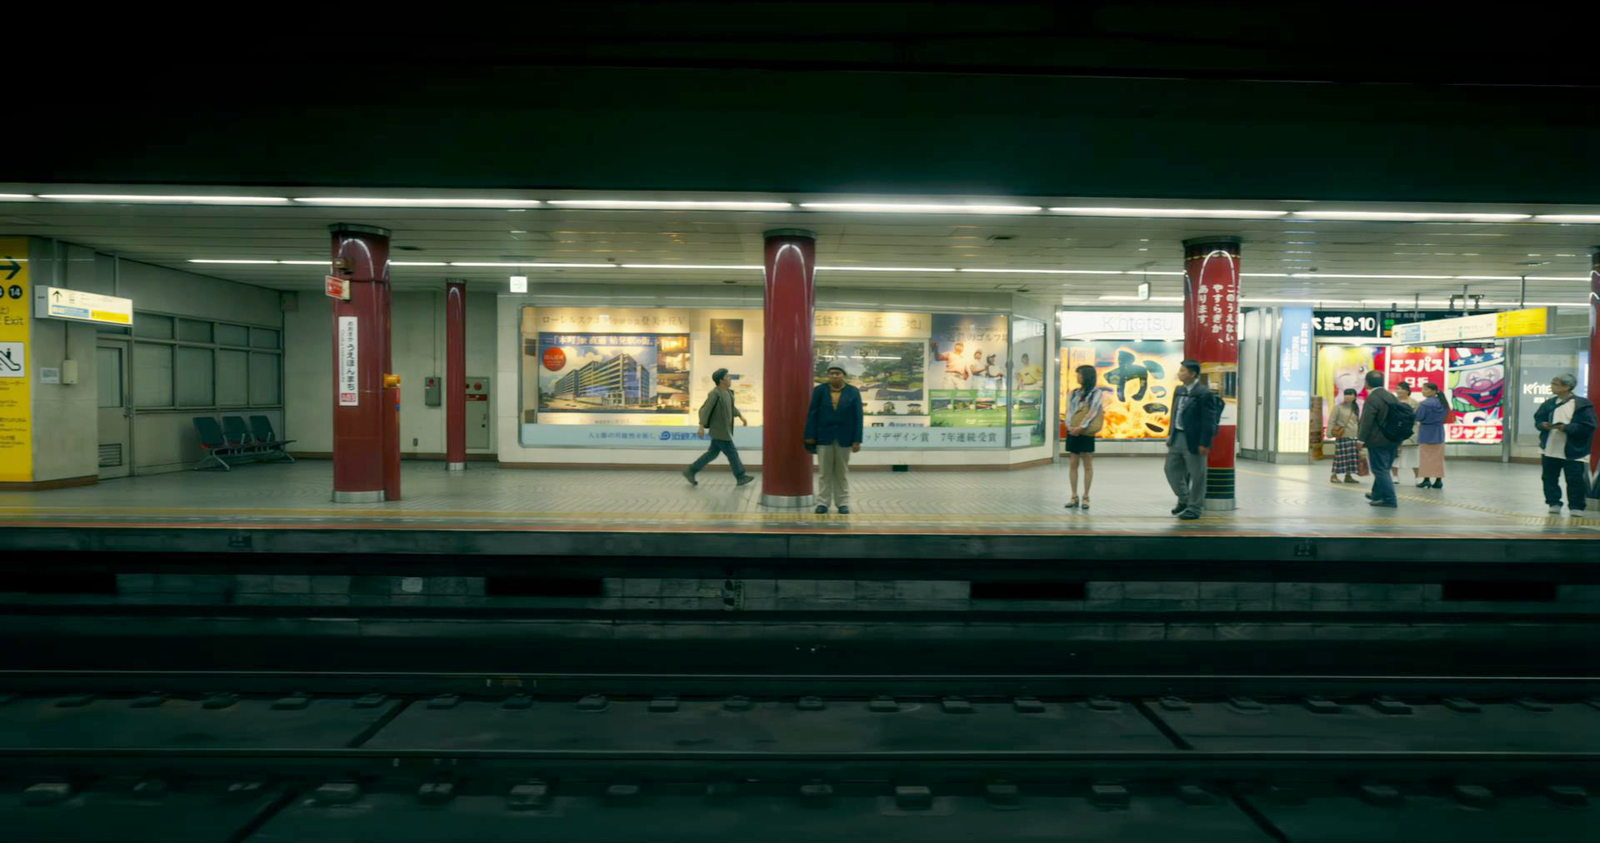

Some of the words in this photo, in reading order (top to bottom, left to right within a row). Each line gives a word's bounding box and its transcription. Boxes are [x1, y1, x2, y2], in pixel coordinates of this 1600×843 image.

[10, 287, 21, 296] 14
[1197, 284, 1209, 327] あります。
[1212, 284, 1224, 343] やすらぎが、
[1226, 284, 1235, 346] このうえない、
[4, 317, 23, 325] Exit
[1390, 356, 1444, 373] エスパス
[1523, 381, 1553, 395] Kinte
[940, 432, 997, 443] 7年連続受賞
[1450, 426, 1503, 439] ジャグラー
